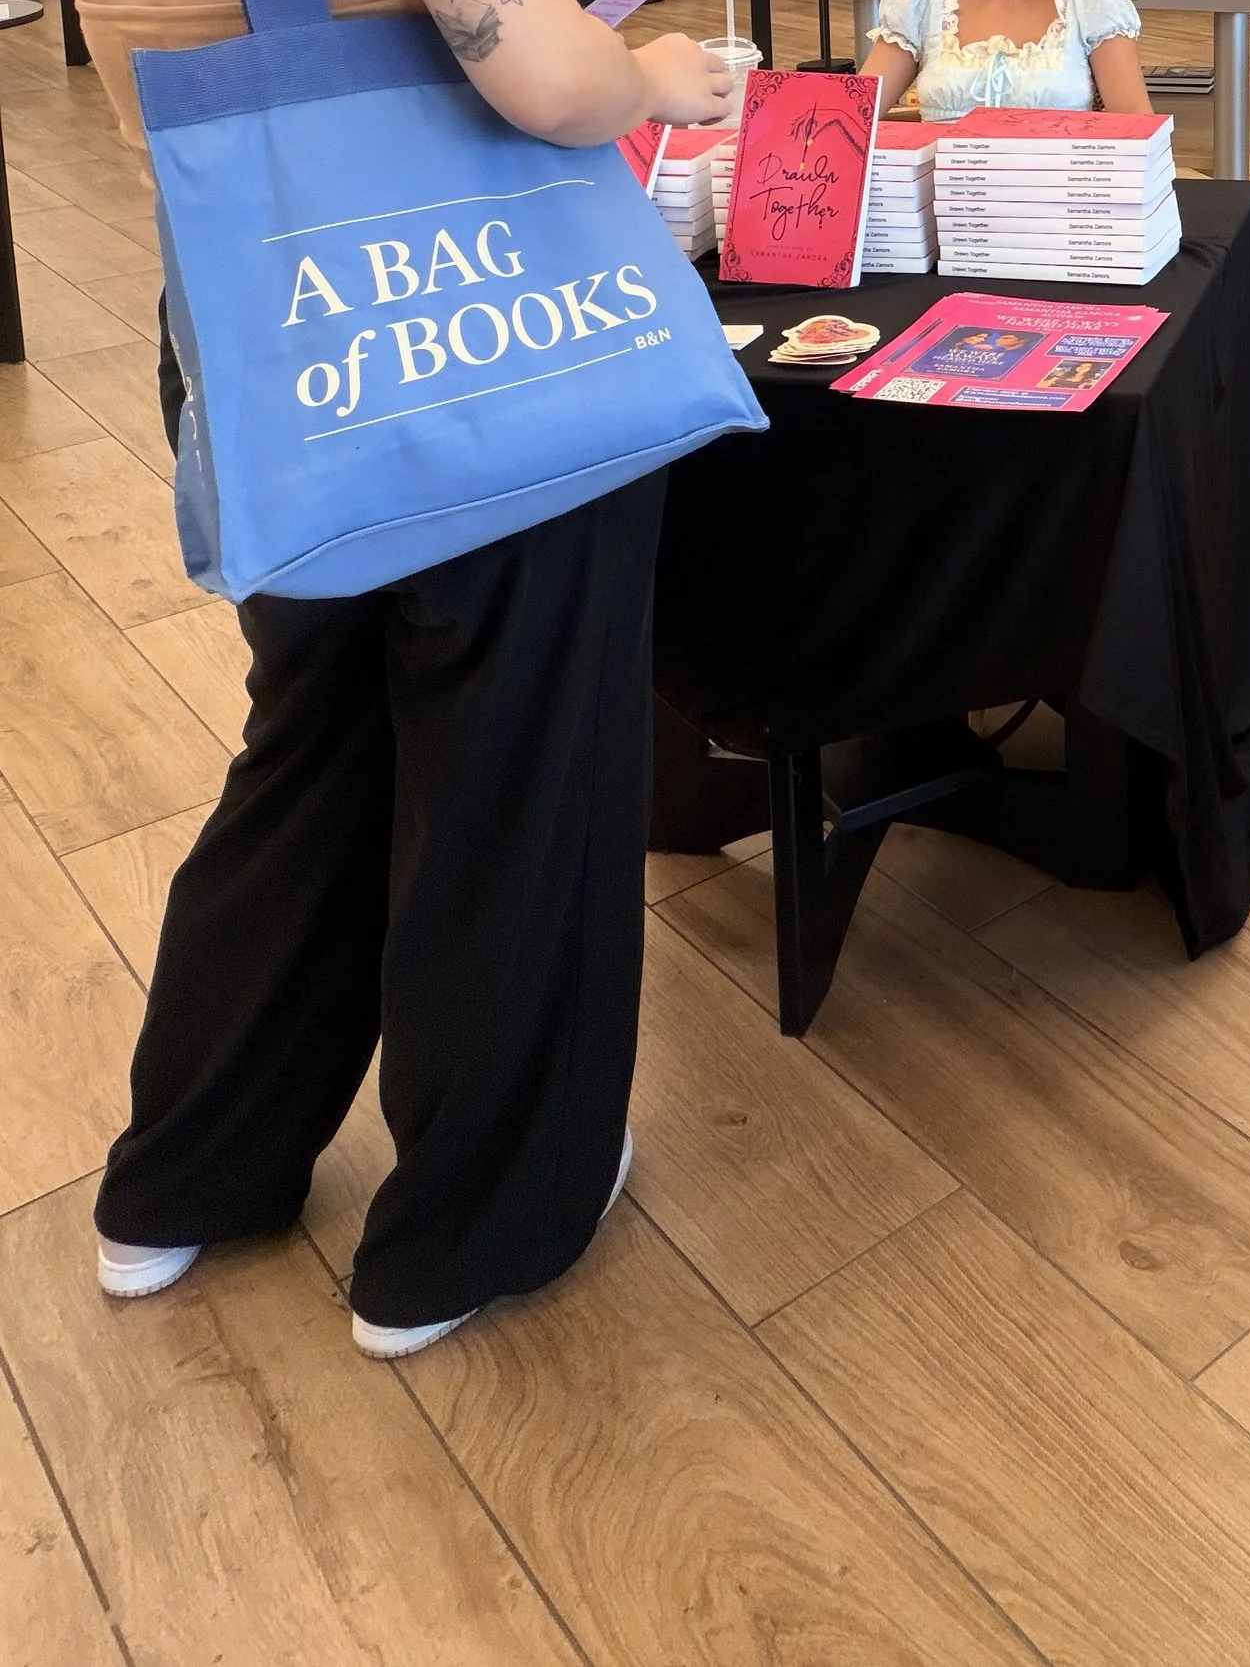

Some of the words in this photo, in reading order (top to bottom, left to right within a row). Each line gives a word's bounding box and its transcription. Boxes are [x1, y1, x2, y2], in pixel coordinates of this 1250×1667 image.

[757, 152, 839, 186] Drawn
[750, 183, 839, 241] Together
[282, 256, 355, 327] A
[360, 220, 526, 306] BAG
[296, 330, 377, 418] of
[386, 265, 658, 385] BOOKS
[634, 327, 672, 351] B&N
